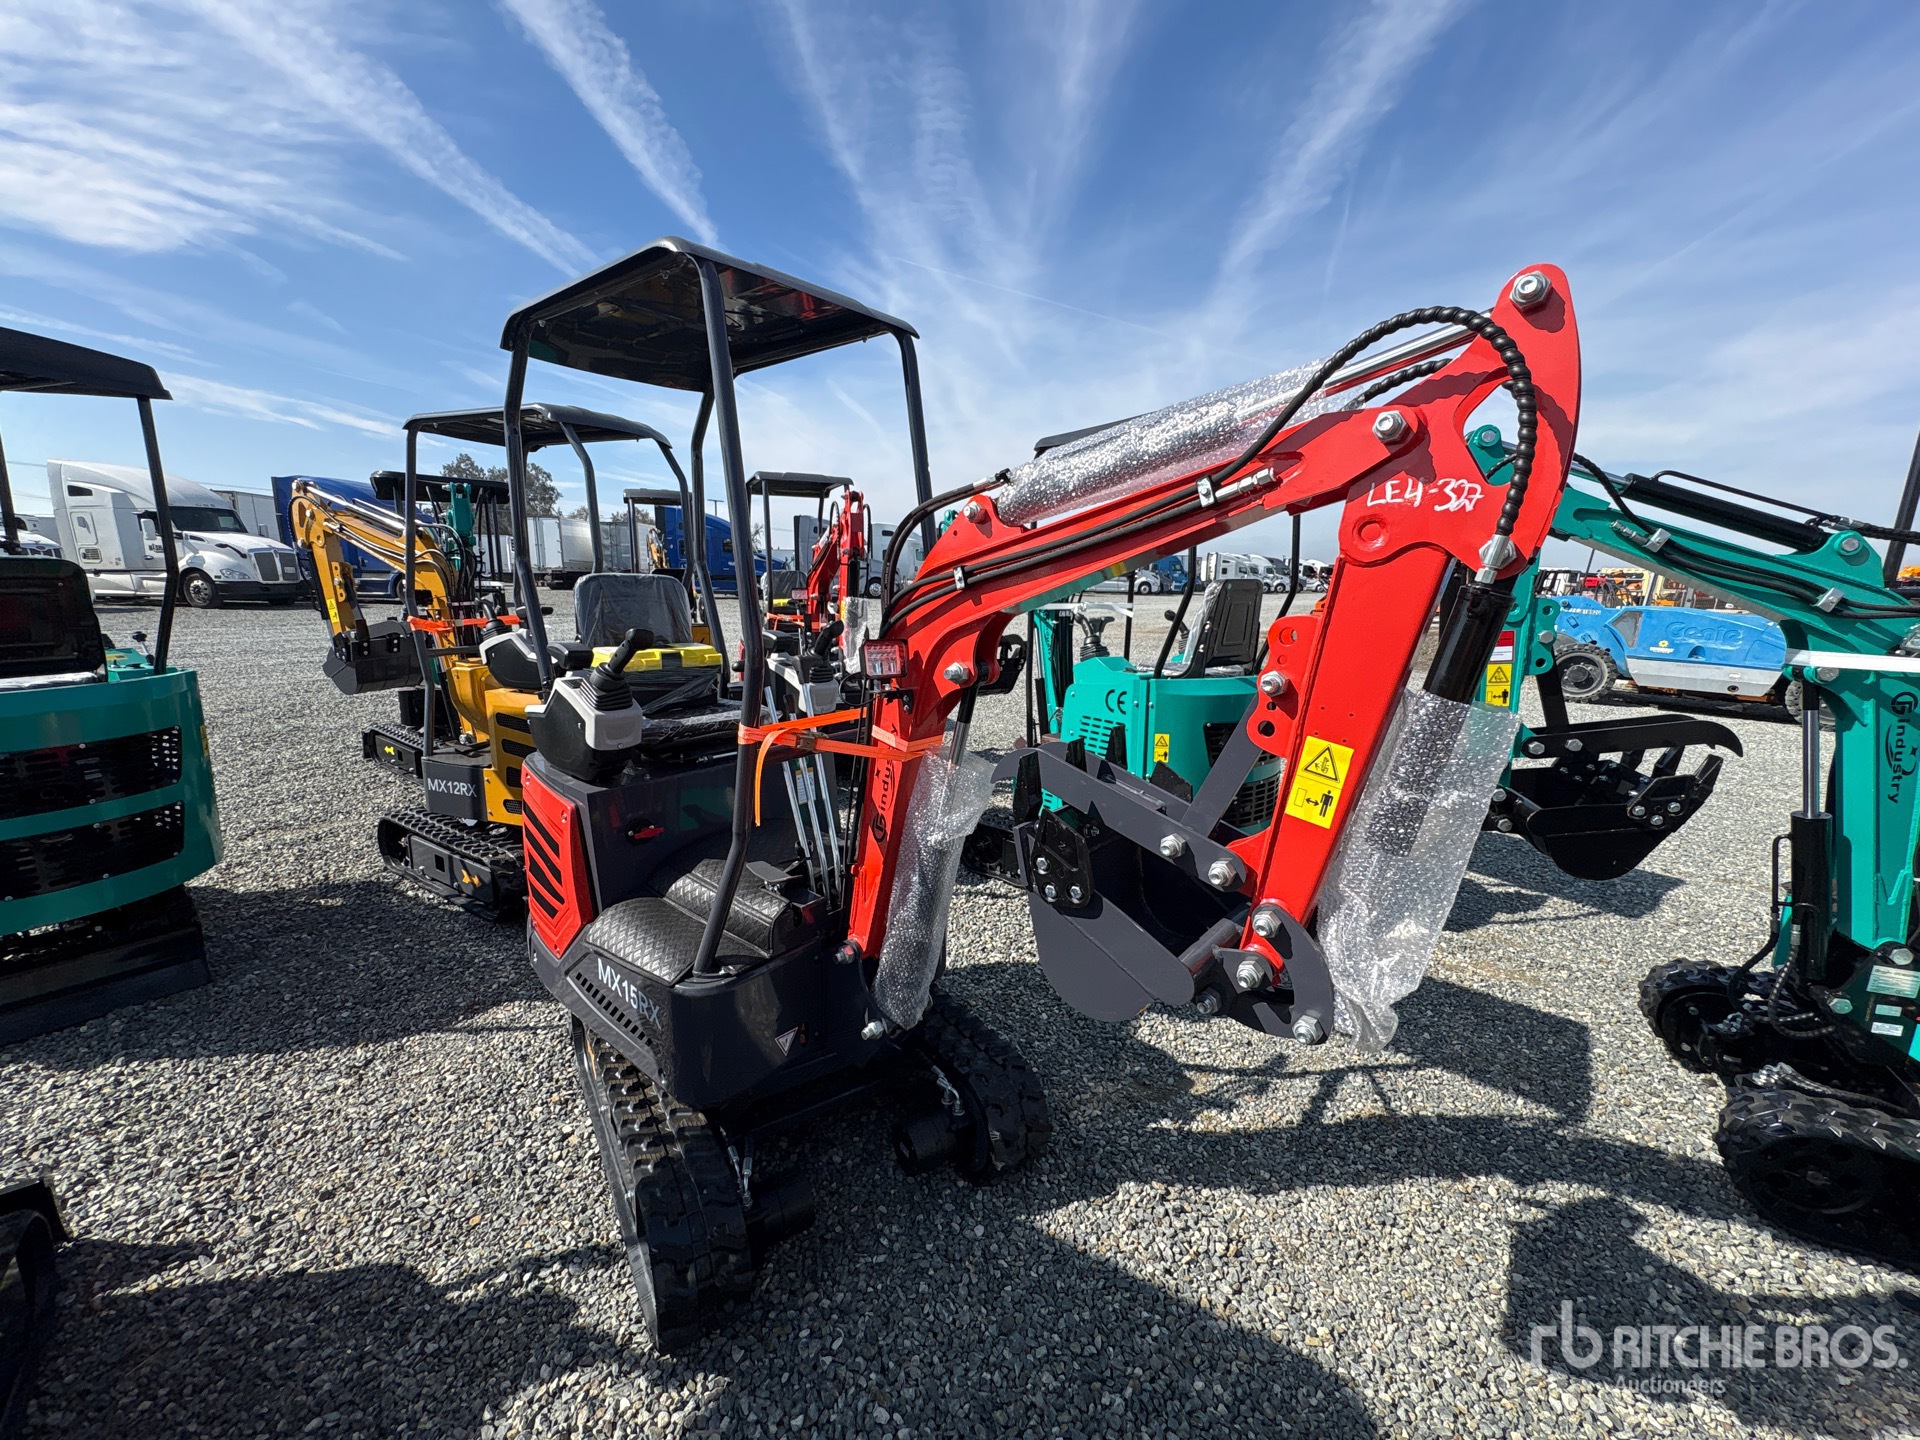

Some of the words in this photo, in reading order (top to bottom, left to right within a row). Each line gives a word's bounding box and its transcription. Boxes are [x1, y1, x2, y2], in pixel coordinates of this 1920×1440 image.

[1366, 478, 1485, 512] LE4-327
[1665, 620, 1743, 643] Genie
[1105, 688, 1127, 715] CE
[427, 777, 477, 797] MX12RX
[597, 957, 661, 1030] MX15RX
